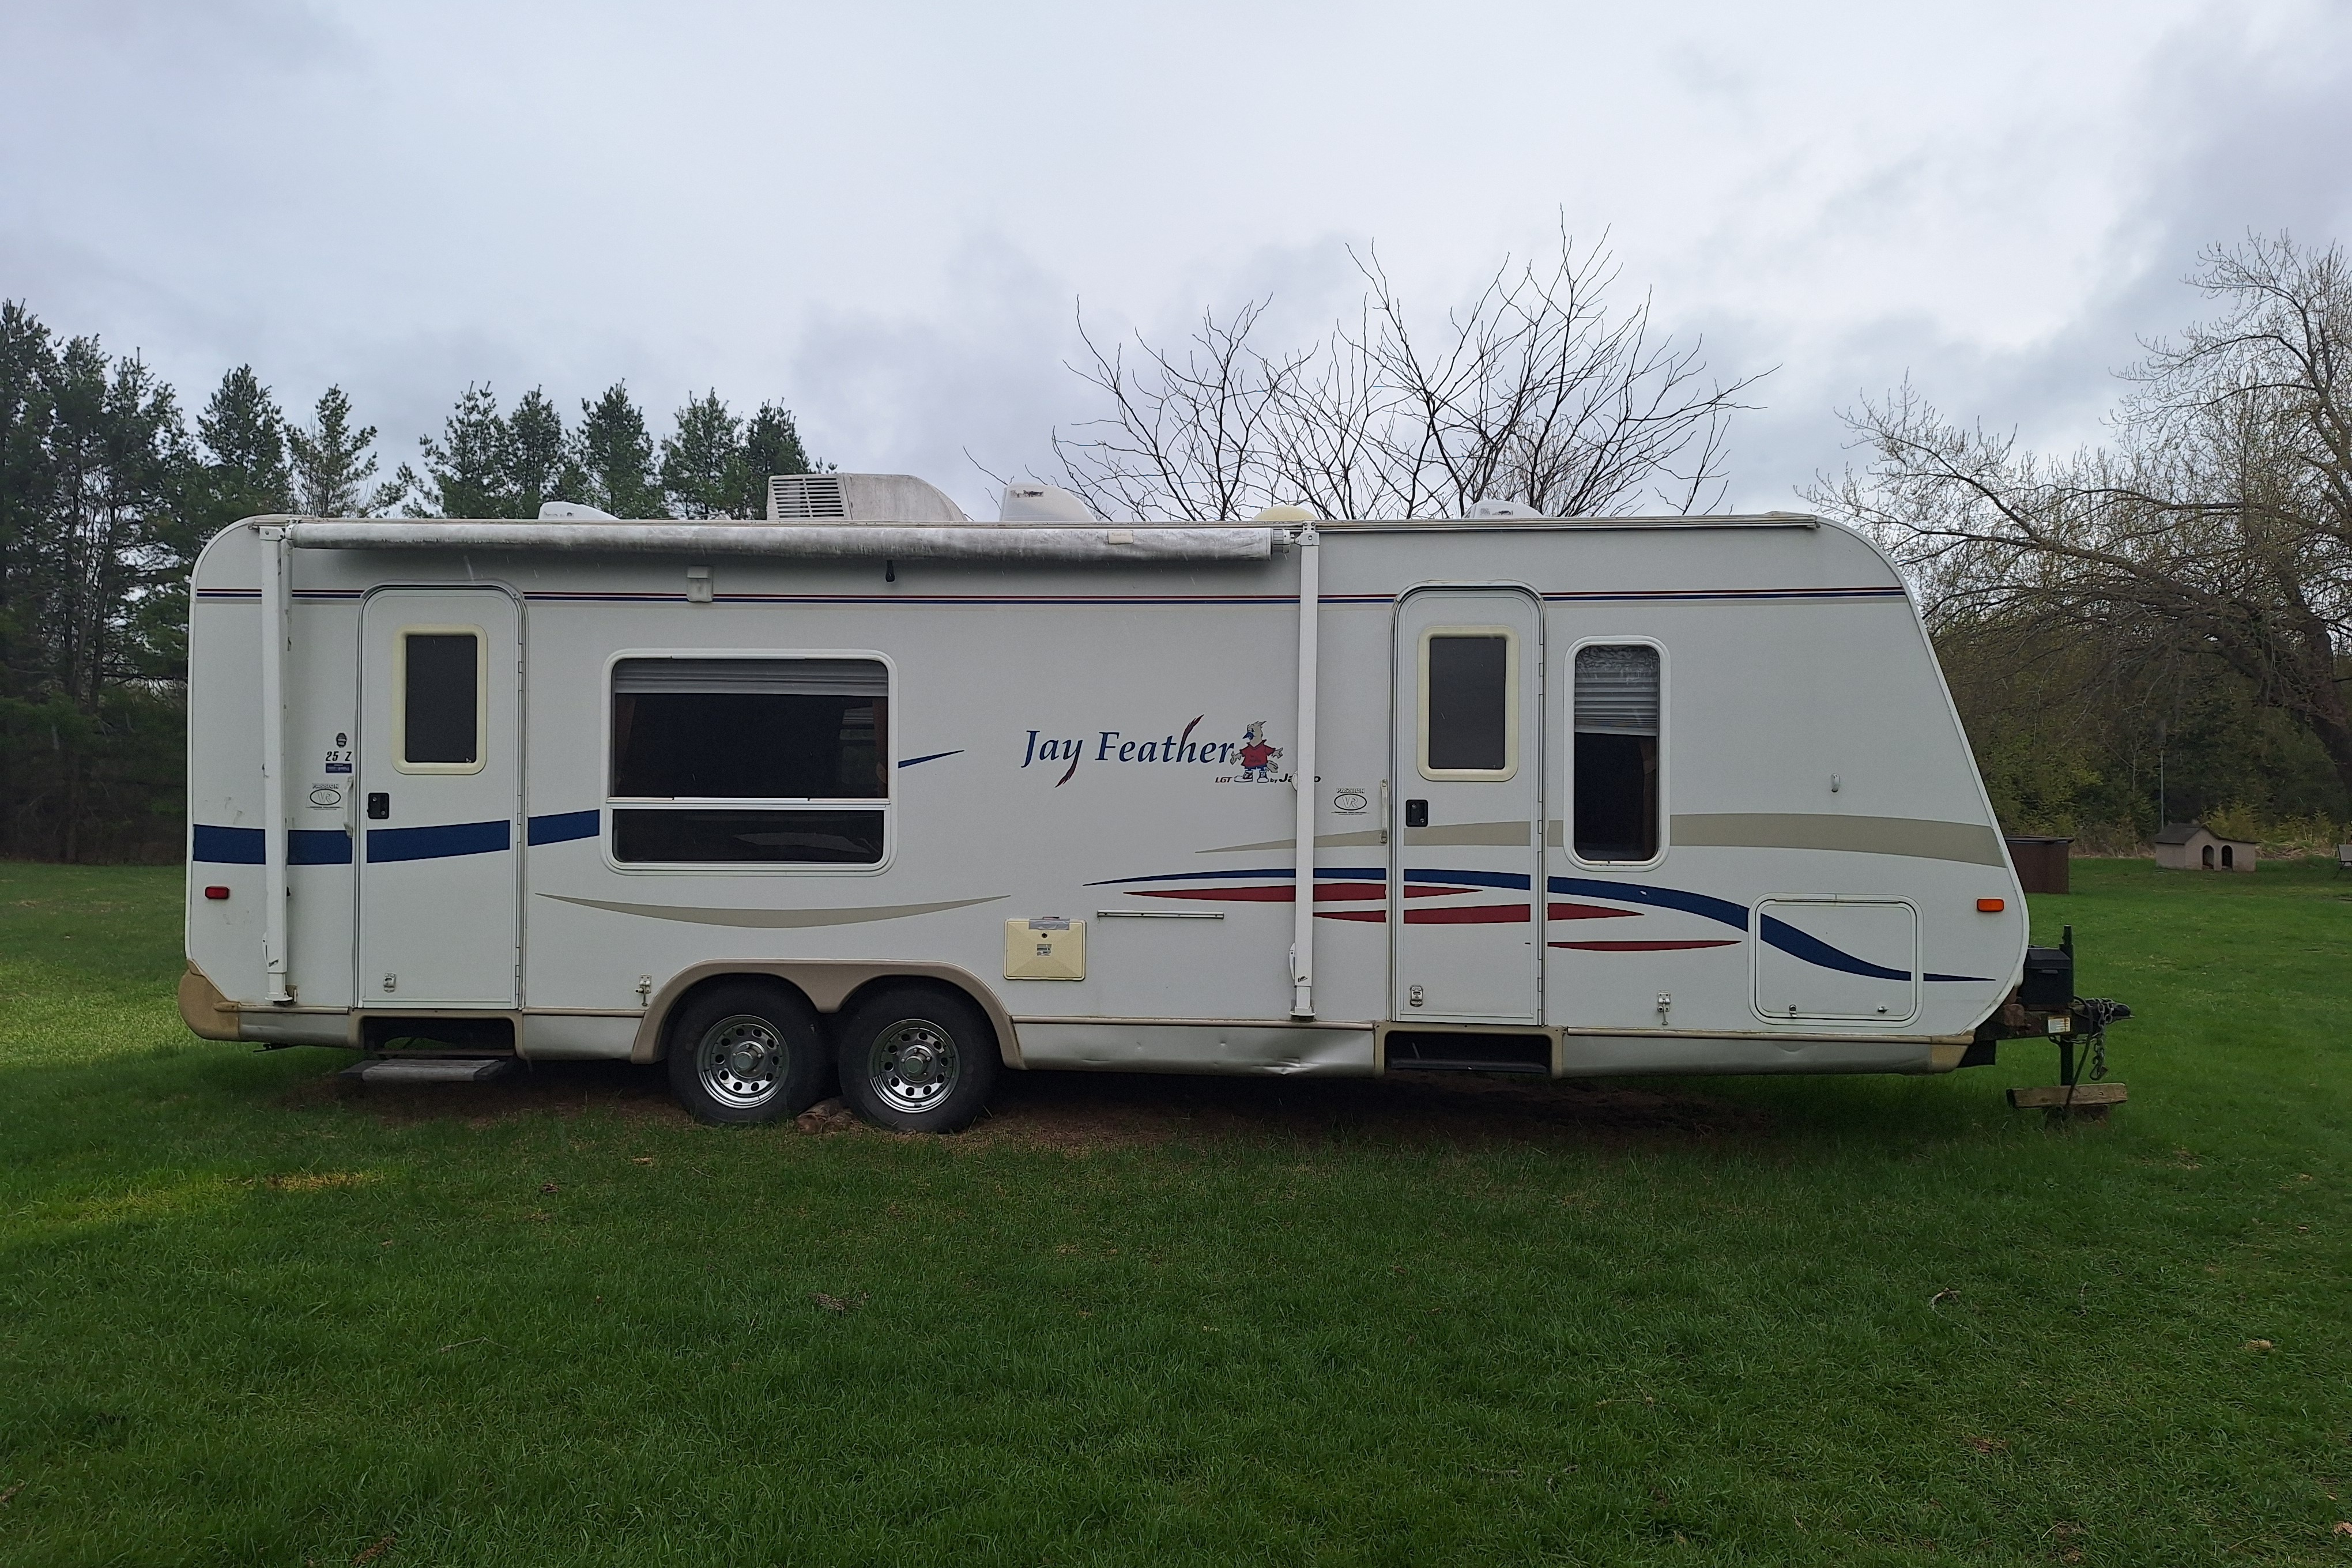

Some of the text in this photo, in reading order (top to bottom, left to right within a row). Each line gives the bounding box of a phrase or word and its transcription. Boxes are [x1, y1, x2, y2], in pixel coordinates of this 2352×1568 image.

[325, 751, 352, 762] 25 Z
[1020, 714, 1235, 788] Jay Feather
[1342, 796, 1359, 808] VR
